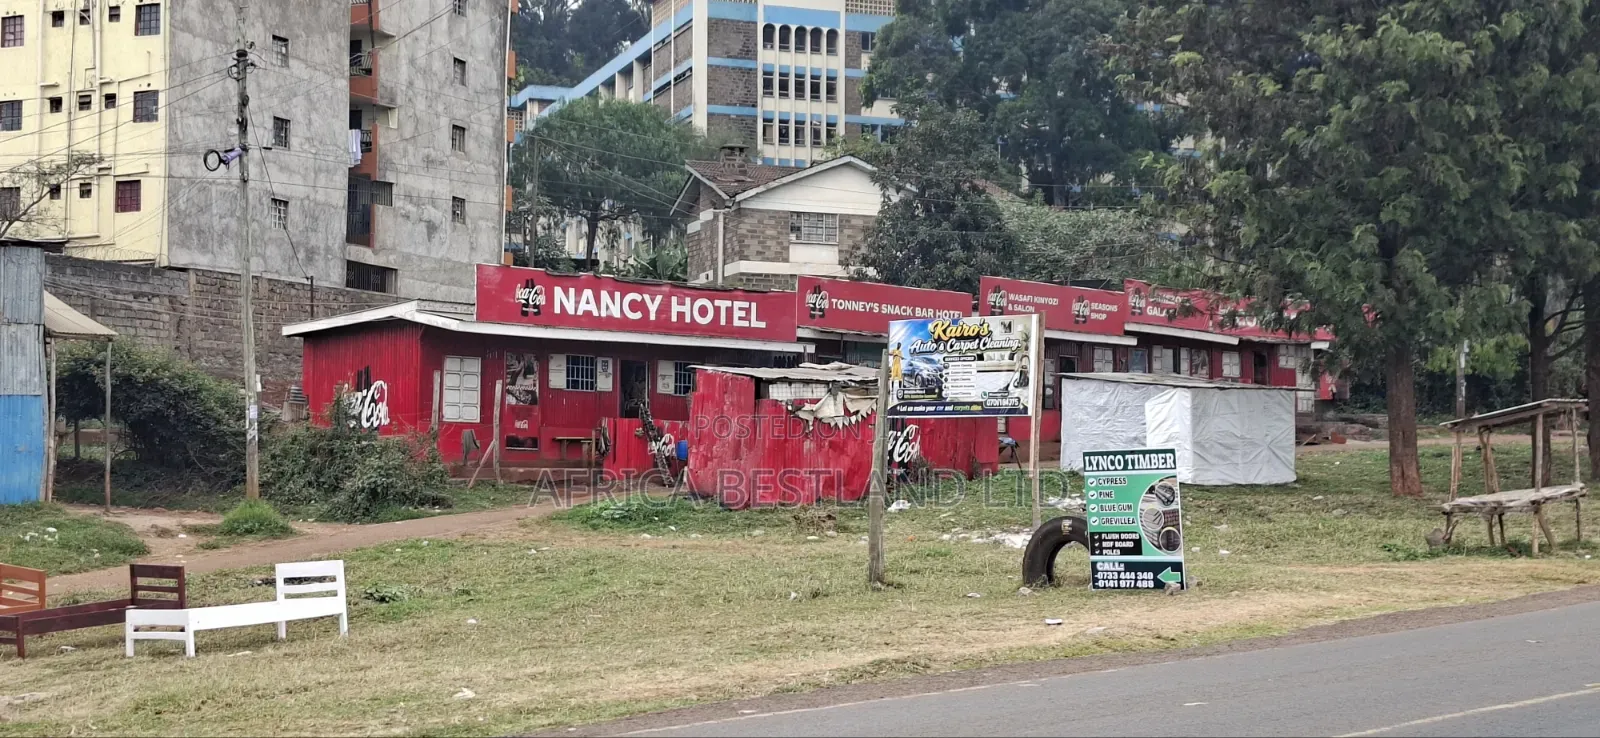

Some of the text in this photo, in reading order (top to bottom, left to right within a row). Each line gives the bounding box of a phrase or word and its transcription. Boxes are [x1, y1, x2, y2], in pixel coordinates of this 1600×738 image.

[1008, 293, 1059, 305] WASAFI KINYOZI
[554, 286, 767, 328] NANCY HOTEL
[831, 298, 879, 313] TONNEY'S
[881, 303, 914, 317] SNACK
[915, 306, 933, 318] BAR
[1008, 303, 1035, 312] & SALON
[1091, 302, 1119, 312] SEASONS
[931, 318, 991, 341] Kairo's
[910, 340, 937, 353] Auto
[947, 338, 979, 353] Carpet
[980, 337, 1021, 352] Cleaning.
[1084, 453, 1175, 471] LYNCO TIMBER
[1097, 477, 1127, 485] CYPRESS
[1118, 503, 1132, 511] GUM
[1101, 517, 1136, 525] GREVILLEA
[1096, 562, 1124, 571] CALL:
[1094, 571, 1154, 580] -0733 444 340
[1119, 580, 1135, 588] 977
